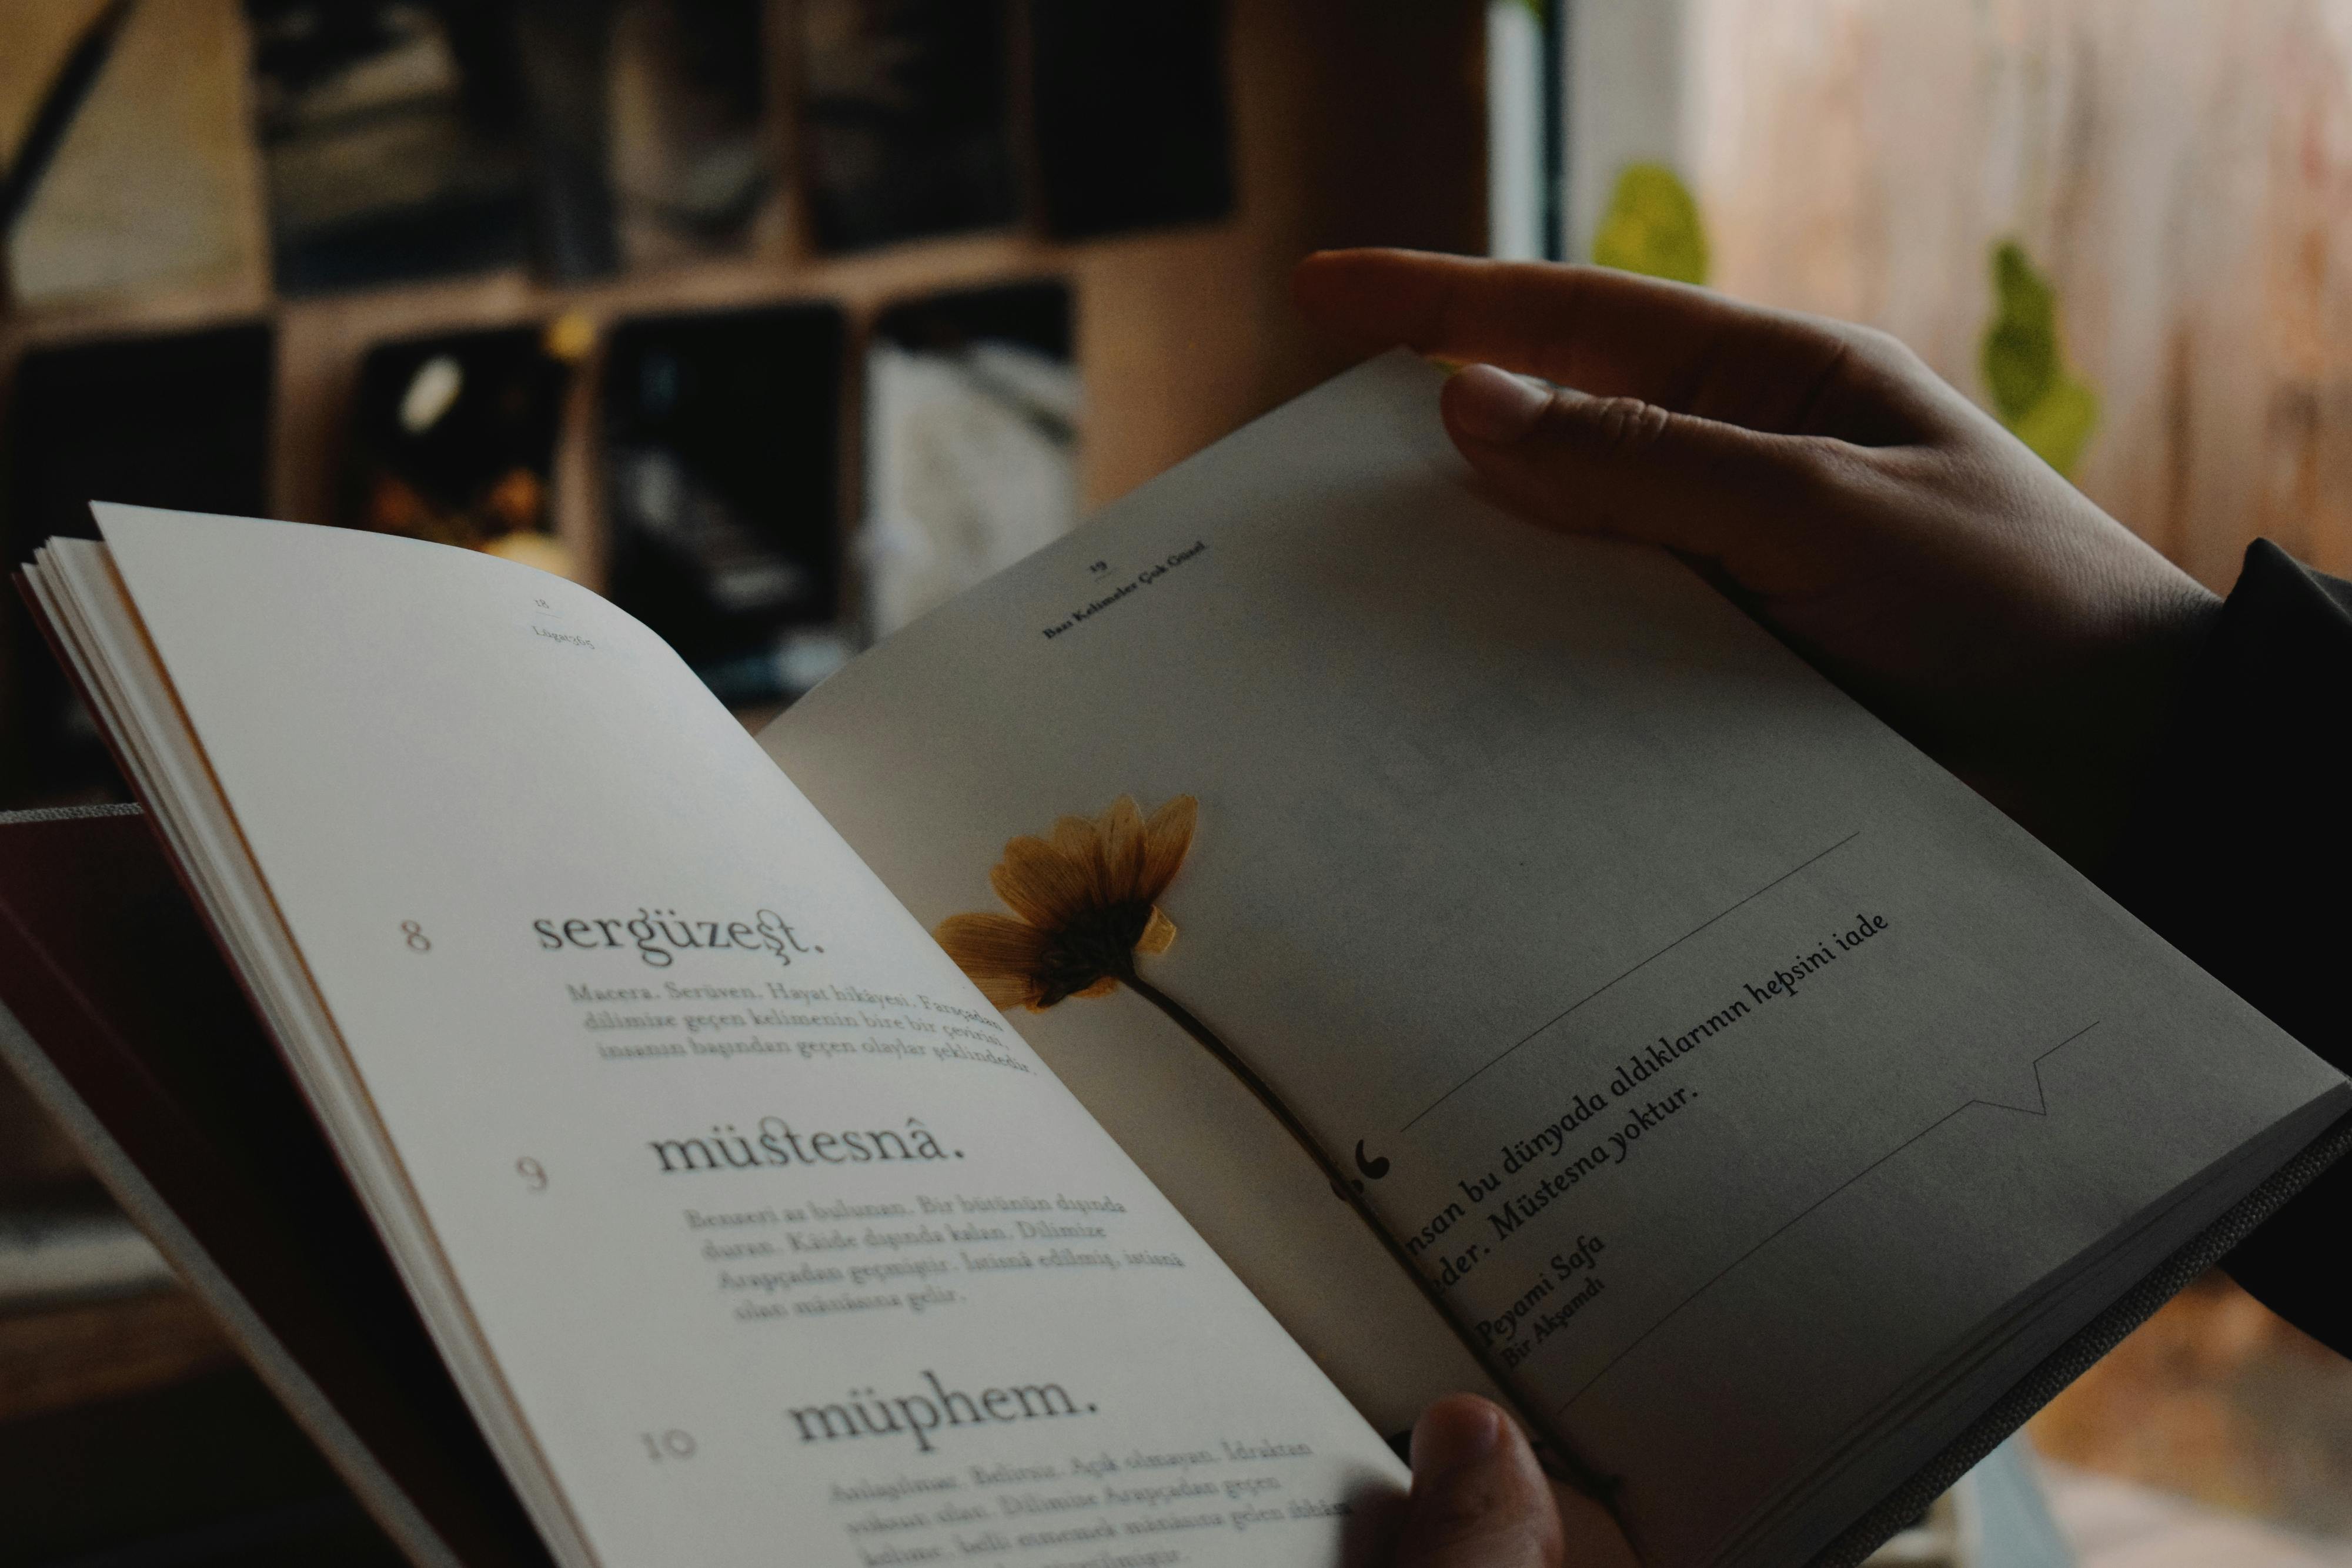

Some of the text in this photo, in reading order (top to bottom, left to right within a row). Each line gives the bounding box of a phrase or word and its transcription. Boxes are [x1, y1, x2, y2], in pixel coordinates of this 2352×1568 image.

[1071, 581, 1138, 623] Kelimeler
[400, 908, 825, 967] 8 sergüzeşt.
[566, 981, 662, 1003] Macera.
[664, 981, 764, 1001] Serüven.
[765, 981, 833, 1005] Hayat
[1405, 911, 1889, 1257] nsan bu dünyada aldıklarının hepsini iade
[516, 1115, 964, 1193] 9 müstesnâ.
[1487, 1145, 1611, 1241] Müstesna
[1609, 1084, 1699, 1164] yoktur.
[1473, 1235, 1606, 1349] Peyami Safa
[1499, 1276, 1606, 1371] Bir Akşamdı
[788, 1369, 1097, 1453] müphem.
